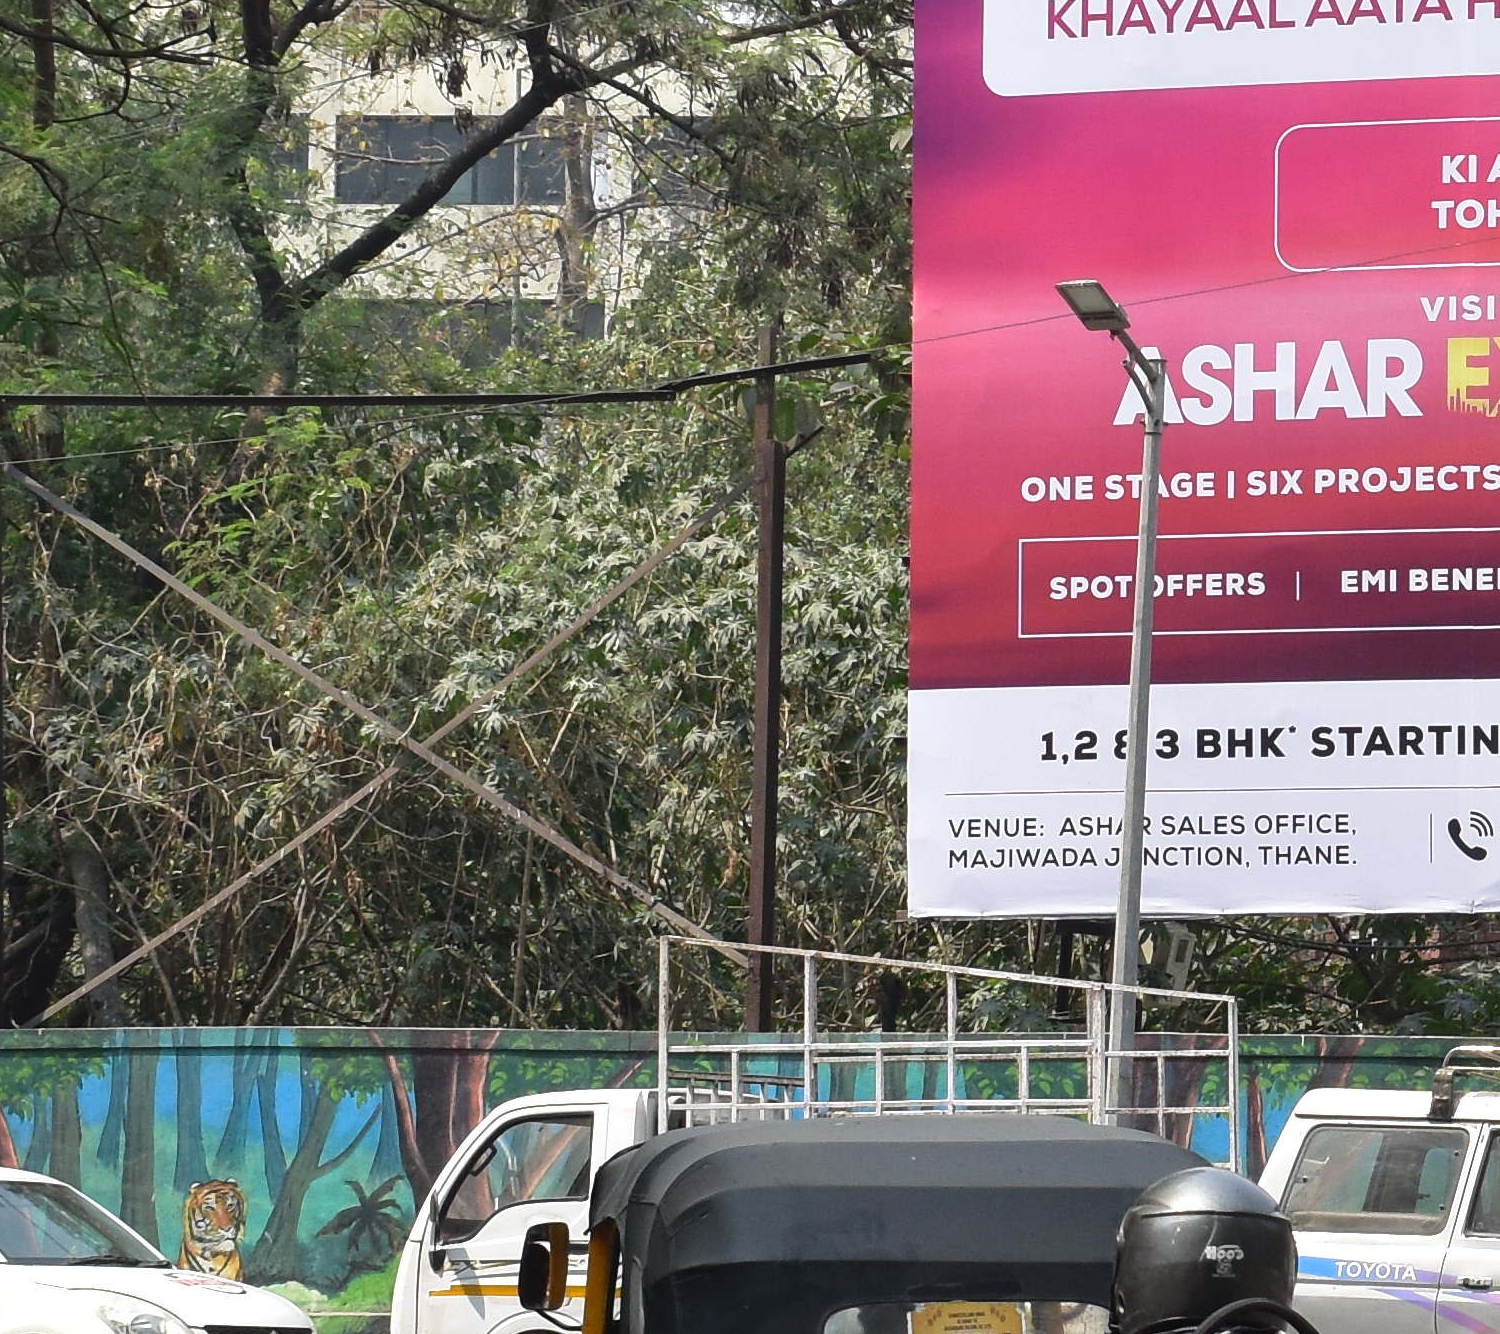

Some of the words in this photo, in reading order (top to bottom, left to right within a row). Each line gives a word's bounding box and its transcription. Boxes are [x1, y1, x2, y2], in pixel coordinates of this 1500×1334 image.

[1440, 154, 1481, 184] KI
[1112, 339, 1423, 426] ASHAR
[1019, 474, 1094, 503] ONE
[1246, 469, 1305, 498] SIX
[1049, 575, 1133, 601] SPOT
[1340, 567, 1399, 594] EMI
[1040, 731, 1098, 765] 1,2
[1154, 729, 1181, 760] 3
[948, 817, 1045, 838] VENUE:
[1160, 814, 1246, 837] SALES
[1253, 813, 1357, 837] OFFICE,
[948, 848, 1097, 869] MAJIWADA
[1104, 846, 1250, 869] JNCTION,
[1258, 845, 1358, 867] THANE.
[1336, 1260, 1417, 1282] TOYOTA
